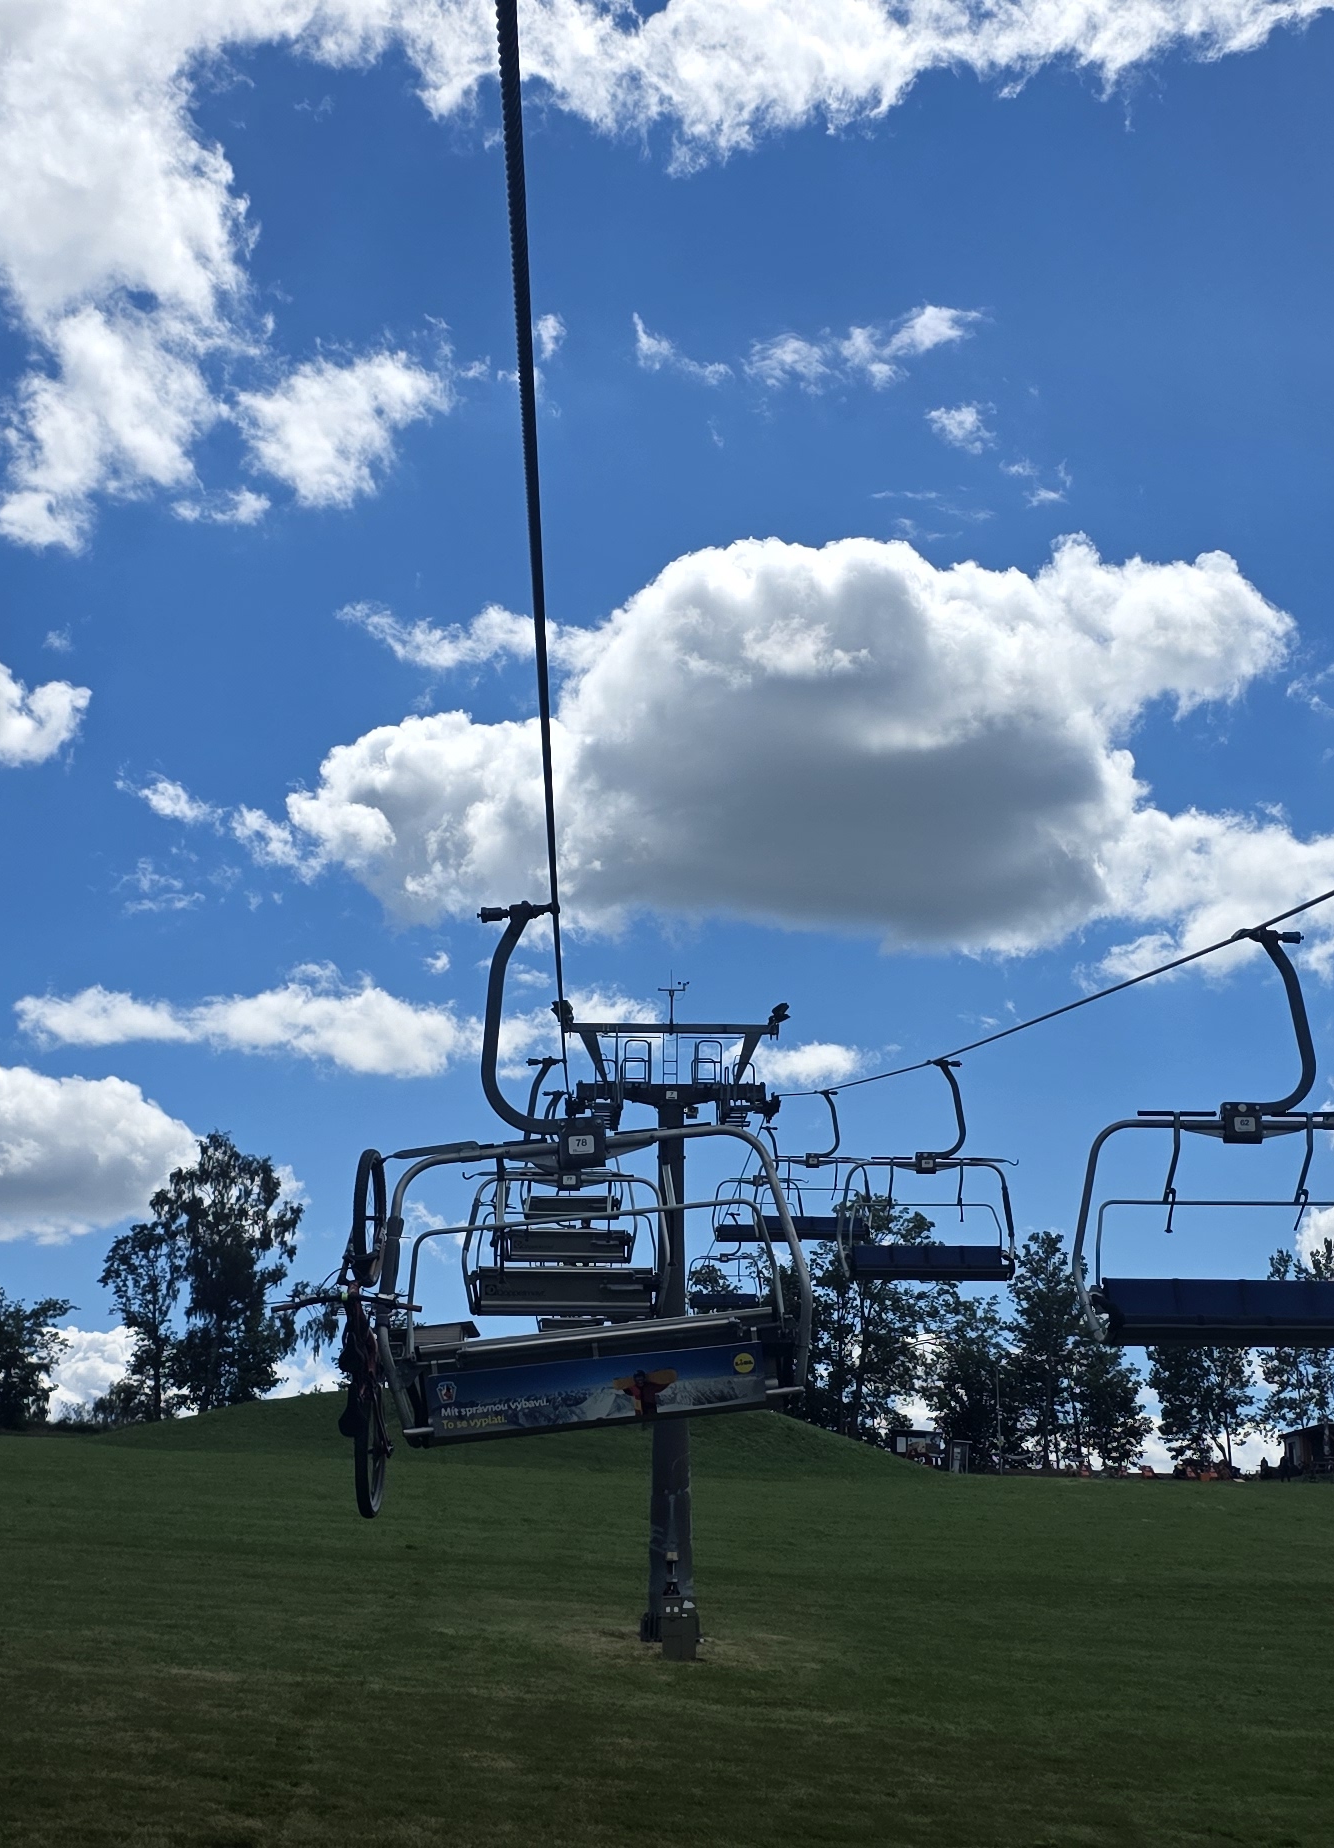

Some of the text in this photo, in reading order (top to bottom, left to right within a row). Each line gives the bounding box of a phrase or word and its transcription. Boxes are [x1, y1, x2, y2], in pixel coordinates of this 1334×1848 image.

[575, 1138, 587, 1147] 78
[441, 1406, 459, 1417] Mít
[460, 1402, 508, 1417] správnou
[441, 1420, 454, 1429] To
[456, 1420, 468, 1428] se
